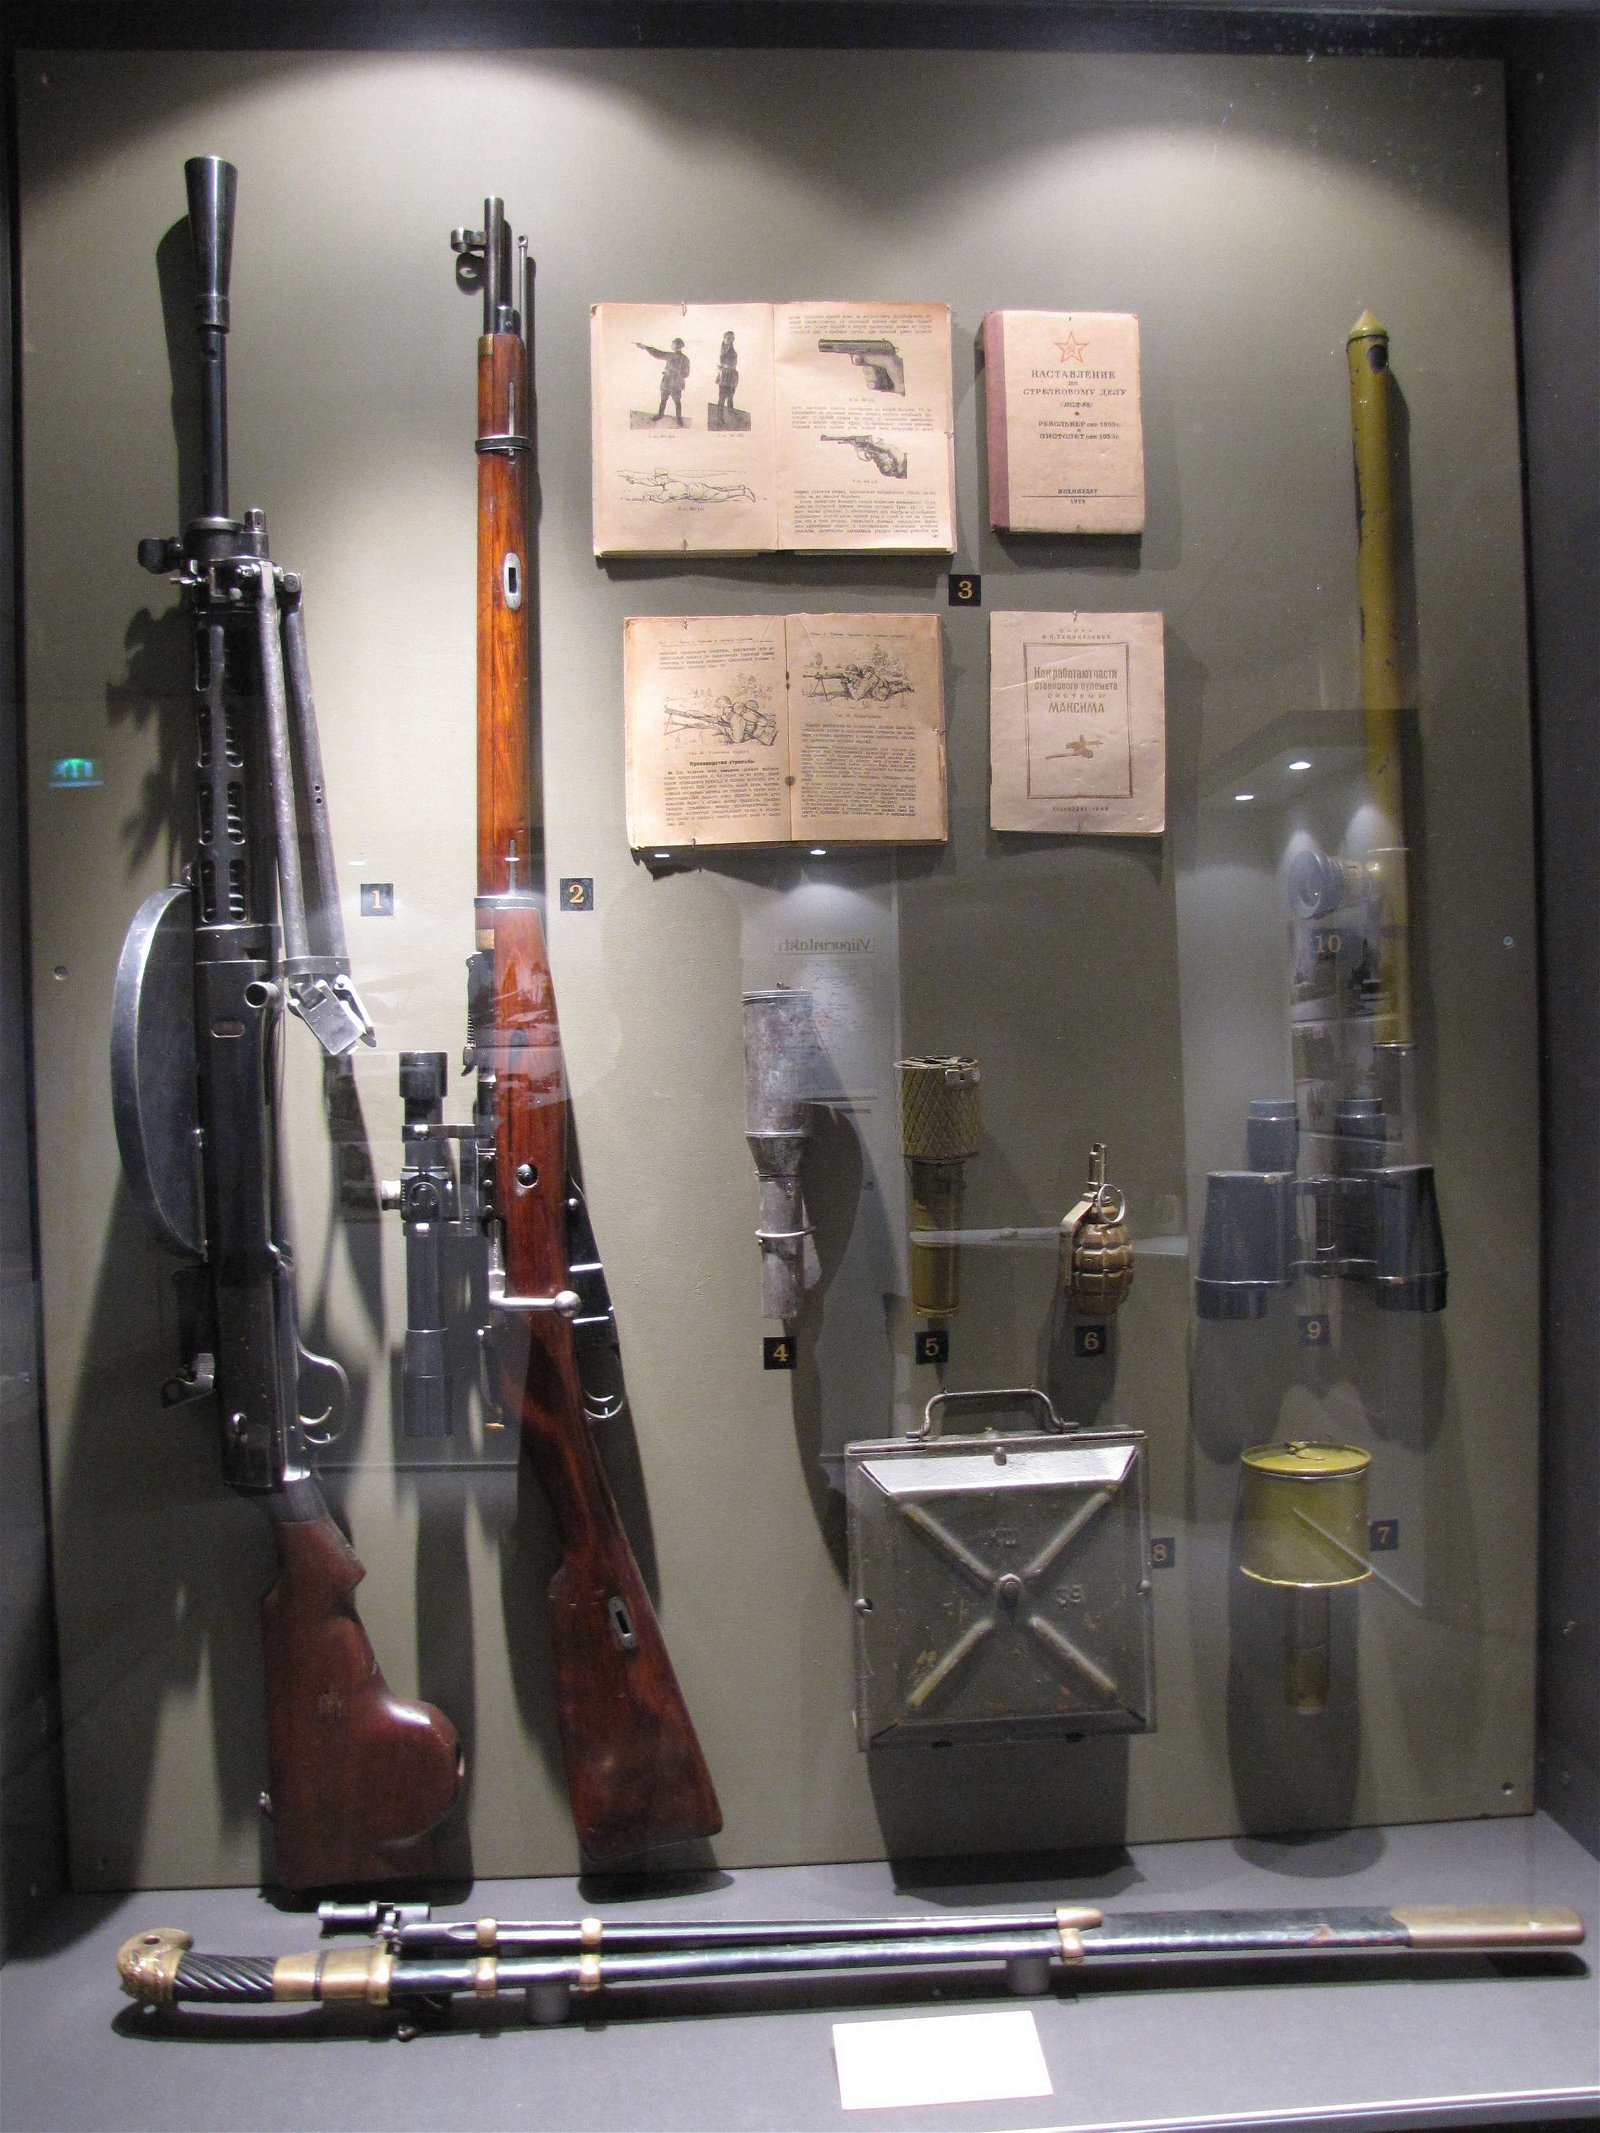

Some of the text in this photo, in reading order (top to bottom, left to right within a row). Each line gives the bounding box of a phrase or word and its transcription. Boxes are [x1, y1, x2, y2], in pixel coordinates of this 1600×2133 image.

[1031, 369, 1116, 379] НАСТАВЛЕНИЕ
[1023, 388, 1127, 397] СТРЕЛКОВОМУ ДЕЛУ
[1038, 420, 1086, 428] РЕВОЛЬВЕР
[958, 581, 973, 599] 3
[1052, 667, 1093, 681] работают
[1094, 668, 1118, 679] части
[1034, 682, 1079, 690] станкового
[1048, 702, 1106, 713] МАКСИМА
[371, 890, 383, 909] 1
[569, 885, 585, 905] 2
[1316, 935, 1342, 954] 10
[1307, 1321, 1322, 1339] 9
[925, 1338, 940, 1356] 5
[1084, 1332, 1099, 1350] 6
[773, 1344, 788, 1362] 4
[1377, 1526, 1391, 1544] 7
[1153, 1544, 1168, 1562] 8
